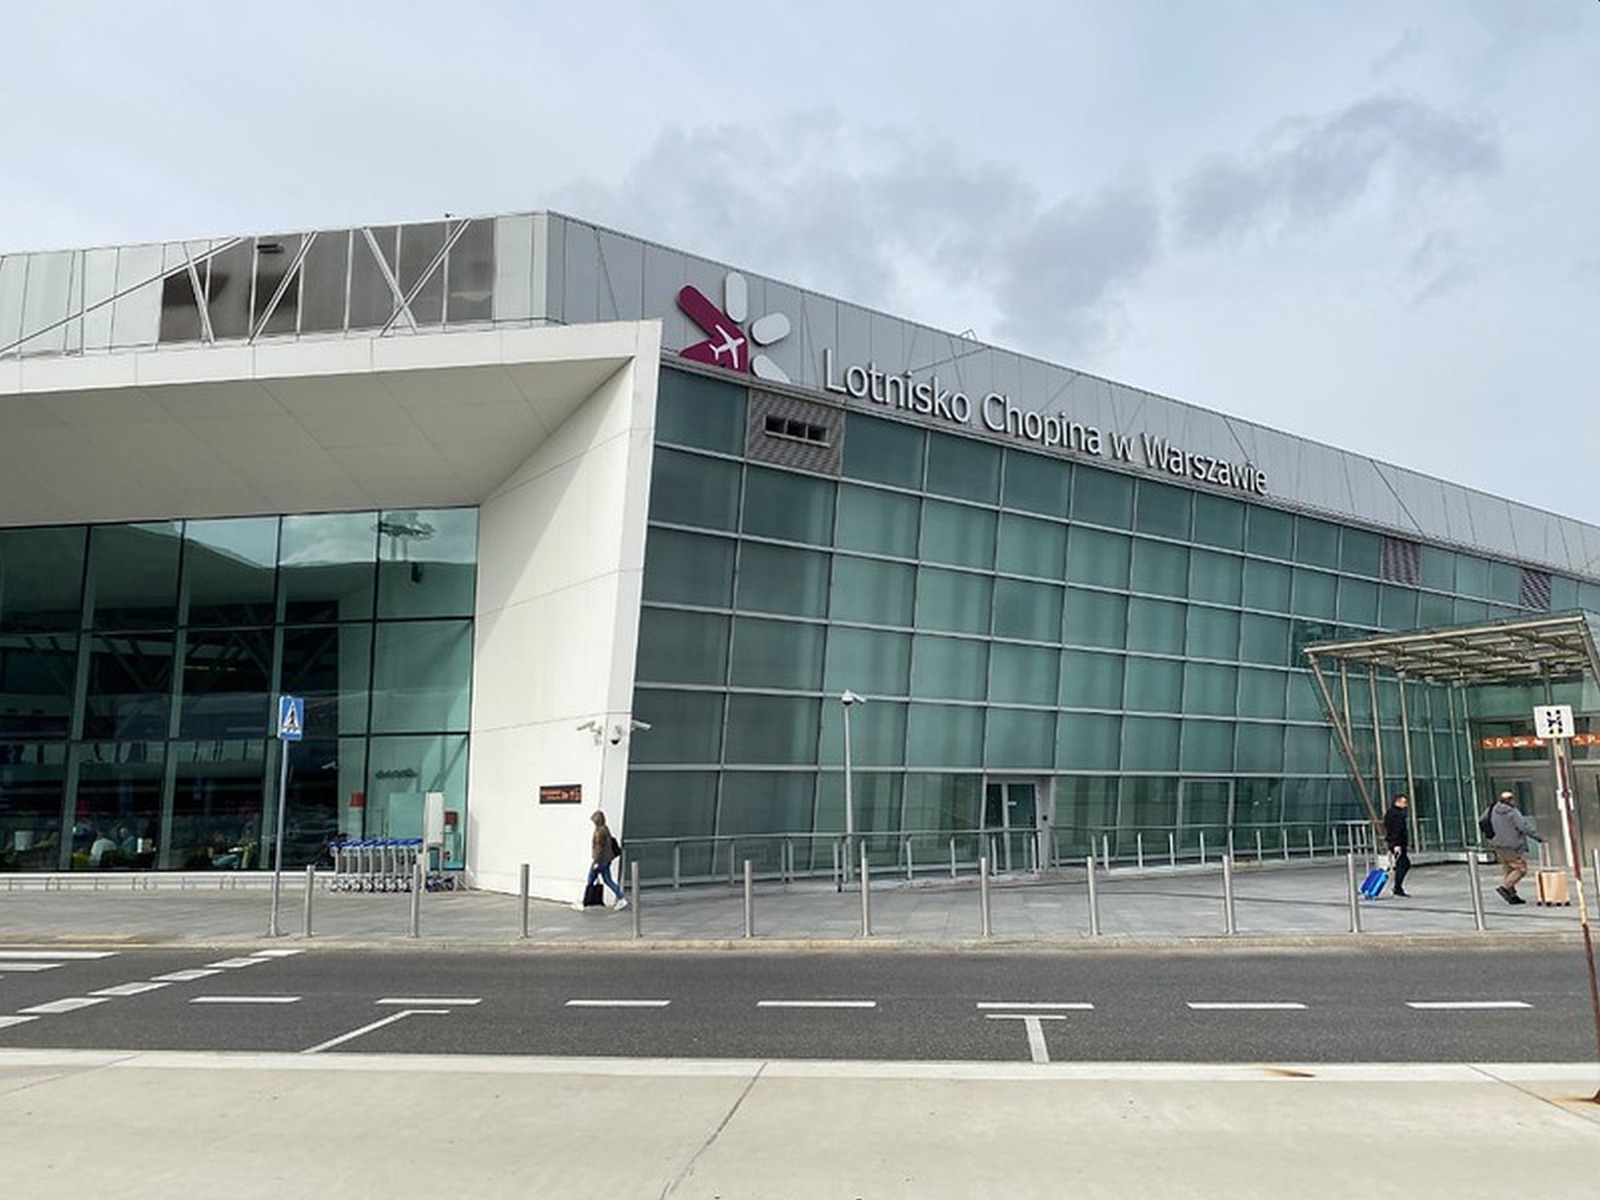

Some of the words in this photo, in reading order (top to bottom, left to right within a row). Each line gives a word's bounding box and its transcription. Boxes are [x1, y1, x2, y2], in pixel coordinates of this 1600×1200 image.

[825, 348, 971, 423] Lotnisko
[981, 393, 1102, 454] Chopina
[1111, 432, 1136, 461] w
[1143, 433, 1269, 495] Warszawie
